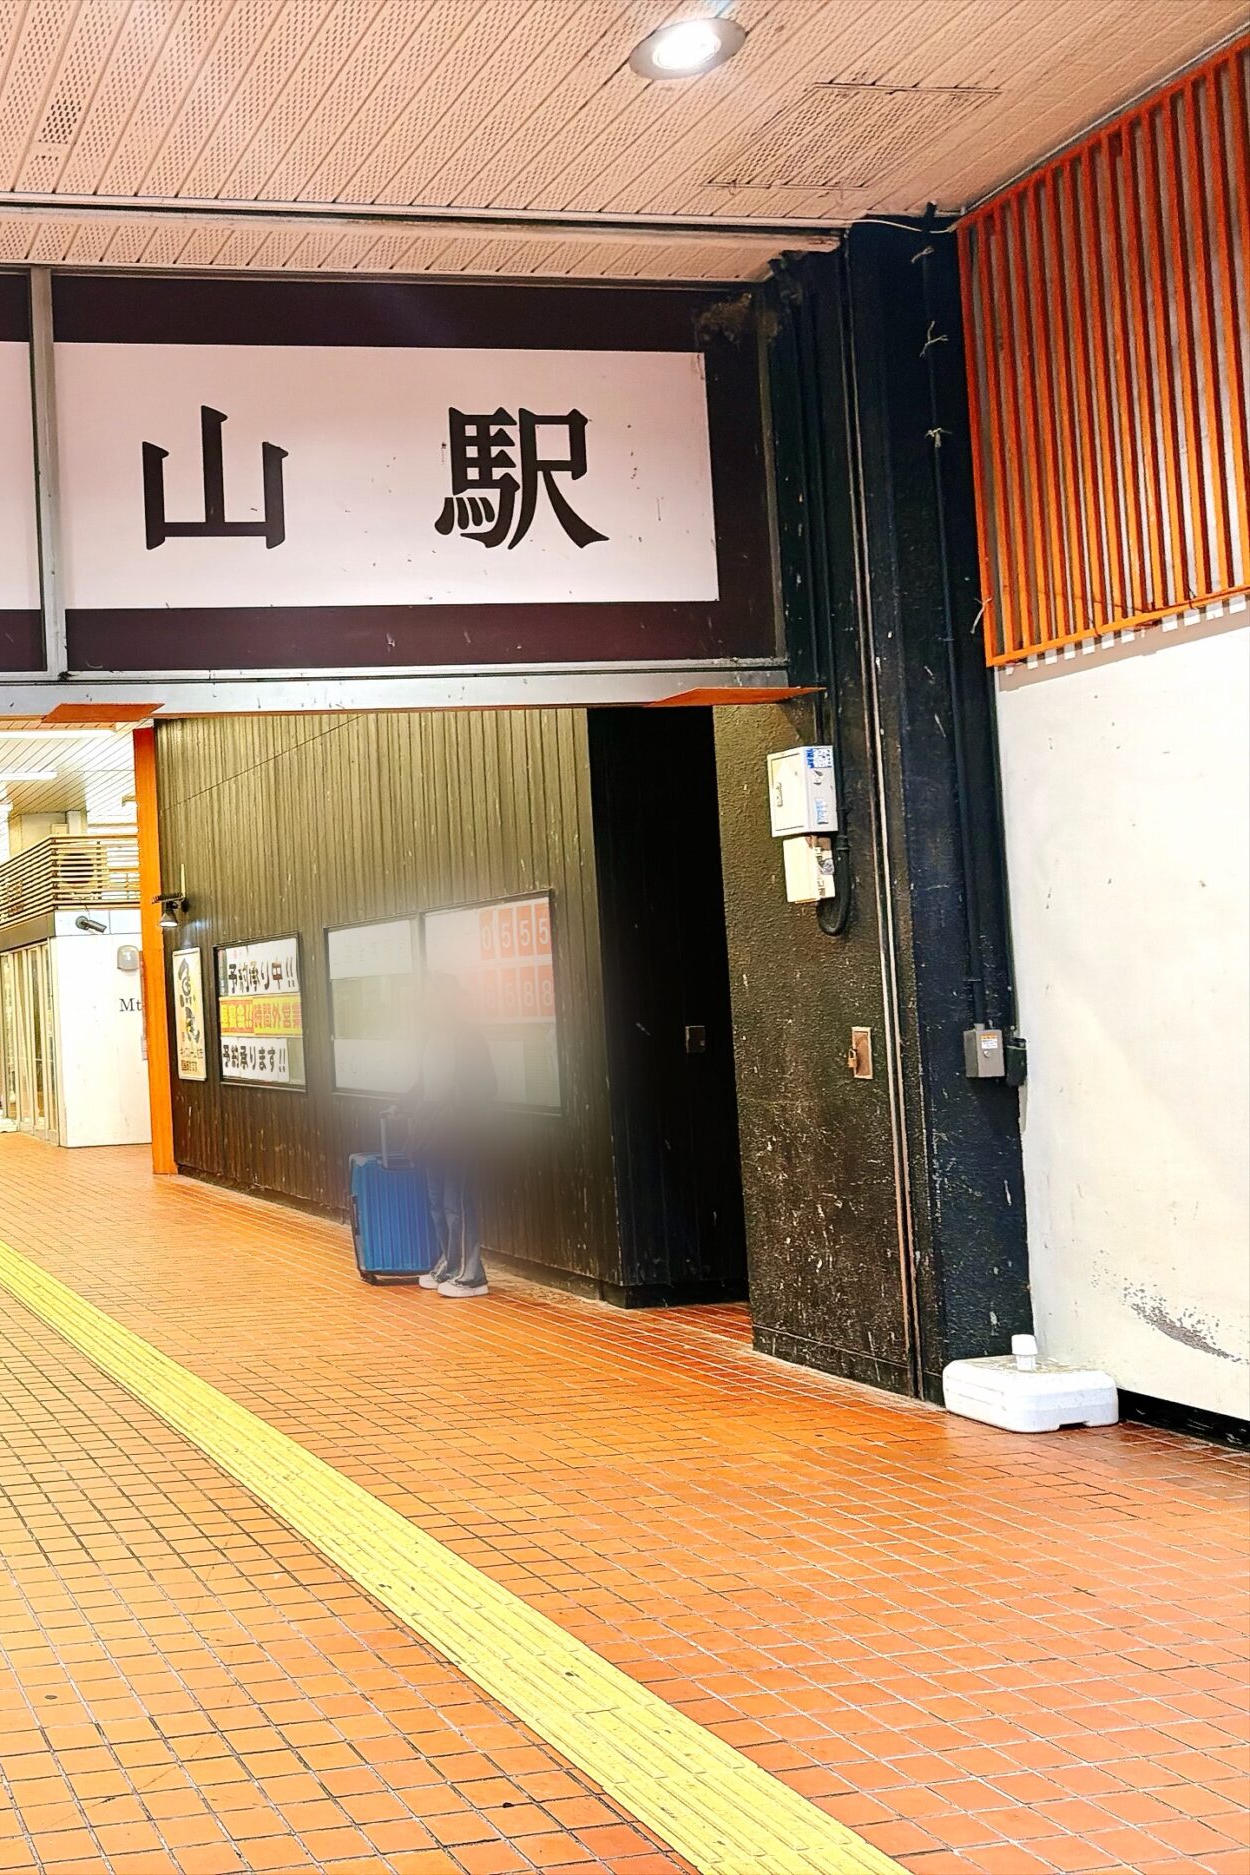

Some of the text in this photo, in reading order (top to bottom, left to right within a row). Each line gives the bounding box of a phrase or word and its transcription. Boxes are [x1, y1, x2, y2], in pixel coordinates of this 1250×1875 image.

[223, 1044, 286, 1073] 予約承ります!!
